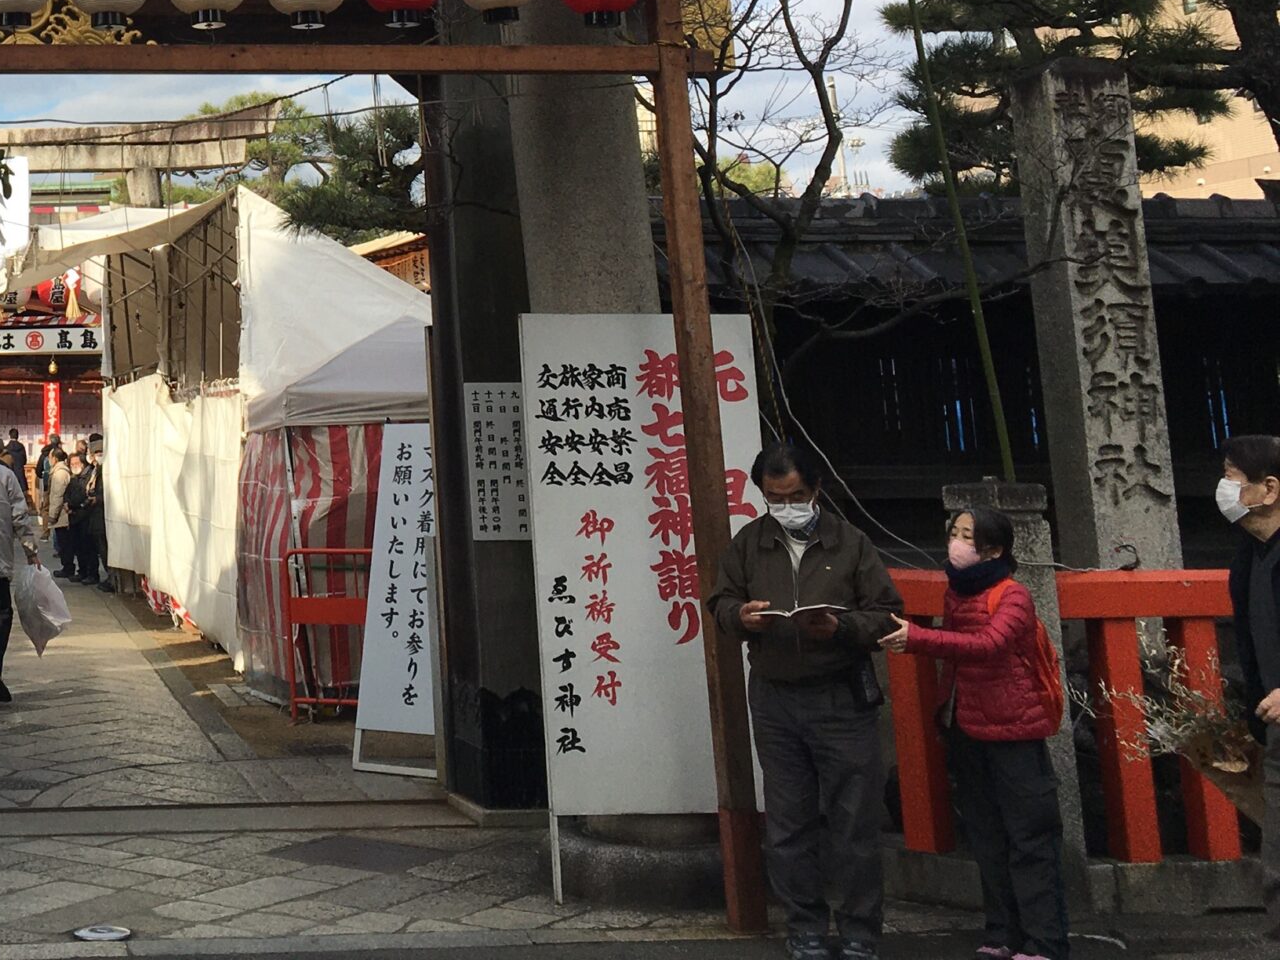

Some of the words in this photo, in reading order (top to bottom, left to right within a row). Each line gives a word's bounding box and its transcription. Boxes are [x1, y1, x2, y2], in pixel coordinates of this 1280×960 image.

[535, 362, 568, 487] 交通安全
[559, 363, 590, 487] 旅行安全
[583, 363, 614, 487] 家内安全
